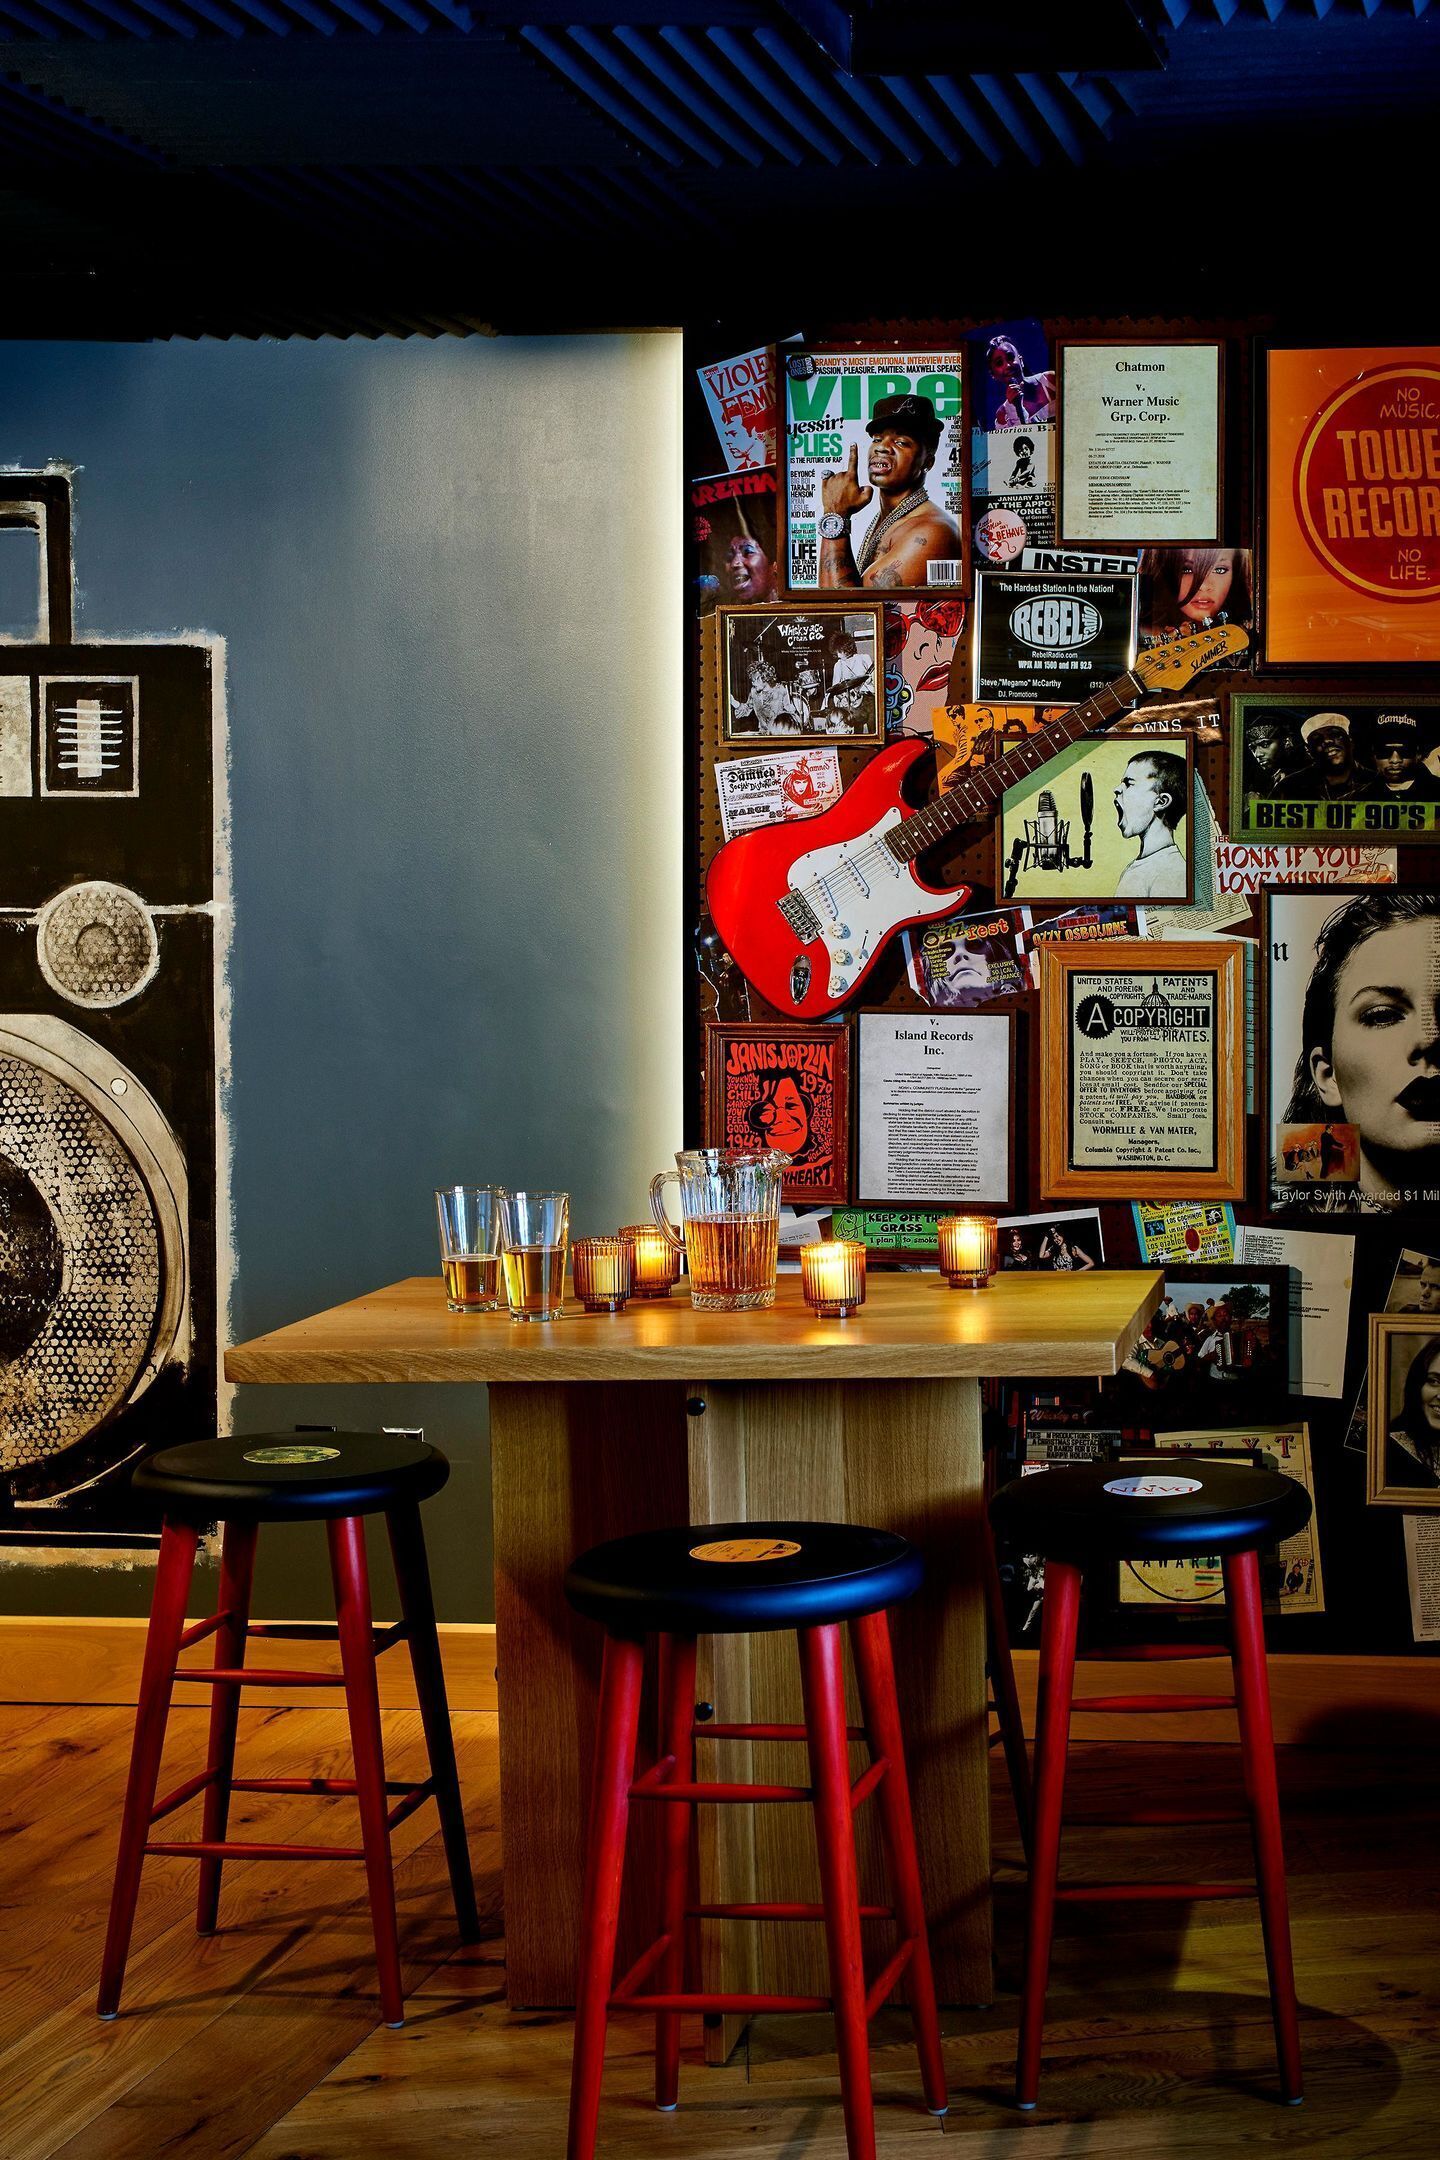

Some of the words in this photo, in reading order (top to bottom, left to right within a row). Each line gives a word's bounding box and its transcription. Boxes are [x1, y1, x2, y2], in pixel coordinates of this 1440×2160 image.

[815, 358, 847, 366] BRANDY'S
[849, 357, 867, 366] MOST
[868, 356, 906, 366] EMOTIONAL
[907, 356, 942, 365] INTERVIEW
[944, 356, 961, 364] EVER
[1115, 361, 1165, 372] Chatmon
[814, 366, 843, 375] PASSION,
[844, 366, 877, 374] PLEASURE,
[879, 366, 906, 374] PANTIES:
[906, 365, 936, 374] MAXWELL
[936, 364, 962, 373] SPEAKS
[1397, 387, 1421, 401] NO
[1102, 396, 1144, 407] Warner
[1146, 396, 1180, 406] Music
[1110, 412, 1136, 424] Grp.
[1138, 411, 1170, 424] Corp.
[786, 414, 844, 440] yessir!
[790, 433, 843, 457] PLIES
[996, 525, 1026, 540] BEHAVE
[792, 544, 817, 560] LIFE
[1397, 549, 1422, 563] NO
[792, 565, 817, 575] DEATH
[1390, 564, 1431, 581] LIFE.
[1000, 582, 1013, 592] The
[1014, 583, 1041, 592] Hardest
[1042, 584, 1067, 592] Station
[1068, 584, 1075, 592] In
[1089, 585, 1114, 593] Nation!
[1014, 600, 1084, 646] REBEL
[1082, 606, 1098, 641] radio
[1032, 651, 1078, 659] RebelRadio.com
[1190, 640, 1228, 674] SLAMMER
[1034, 661, 1043, 669] AM
[1058, 661, 1070, 669] and
[1071, 661, 1079, 669] FM
[1080, 661, 1092, 670] 92.5
[1032, 679, 1061, 688] McCarthy
[1196, 714, 1220, 729] IT
[1378, 714, 1417, 728] Compton
[817, 781, 826, 789] 26
[728, 805, 771, 818] MARCH
[1256, 803, 1318, 829] BEST
[1326, 803, 1357, 829] OF
[1365, 804, 1426, 830] 90'S
[1215, 846, 1279, 869] HONK
[1285, 846, 1308, 869] IF
[1313, 845, 1361, 868] YOU
[1218, 871, 1272, 894] LOVE
[1032, 930, 1061, 947] OZZY
[1065, 921, 1128, 941] OSBOURNE
[987, 960, 1015, 970] EXCLUSIVE
[986, 973, 1021, 983] APPEARANCE
[1163, 978, 1208, 986] PATENTS
[1086, 1003, 1108, 1031] A
[1113, 1008, 1206, 1026] COPYRIGHT
[895, 1030, 927, 1040] Island
[930, 1031, 974, 1041] Records
[1162, 1030, 1210, 1043] PIRATES.
[924, 1045, 944, 1055] Inc.
[726, 1042, 777, 1075] JANIS
[778, 1044, 833, 1080] JOPLIN
[800, 1072, 833, 1094] 1970
[727, 1090, 760, 1100] CHILD
[813, 1108, 832, 1117] BIG
[727, 1116, 748, 1124] FEEL
[1092, 1126, 1136, 1135] WORMELLE
[1140, 1126, 1145, 1134] &
[1150, 1126, 1165, 1134] VAN
[1168, 1126, 1197, 1136] MATER,
[1276, 1190, 1310, 1202] Taylor
[1314, 1189, 1345, 1200] Swith
[1348, 1190, 1400, 1200] Awarded
[1404, 1190, 1418, 1201] $1
[868, 1214, 896, 1223] KEEP
[900, 1213, 921, 1222] OFF
[880, 1224, 923, 1233] GRASS
[876, 1237, 894, 1245] plan
[1147, 1242, 1158, 1250] LOS
[1142, 1556, 1216, 1568] AWARD
